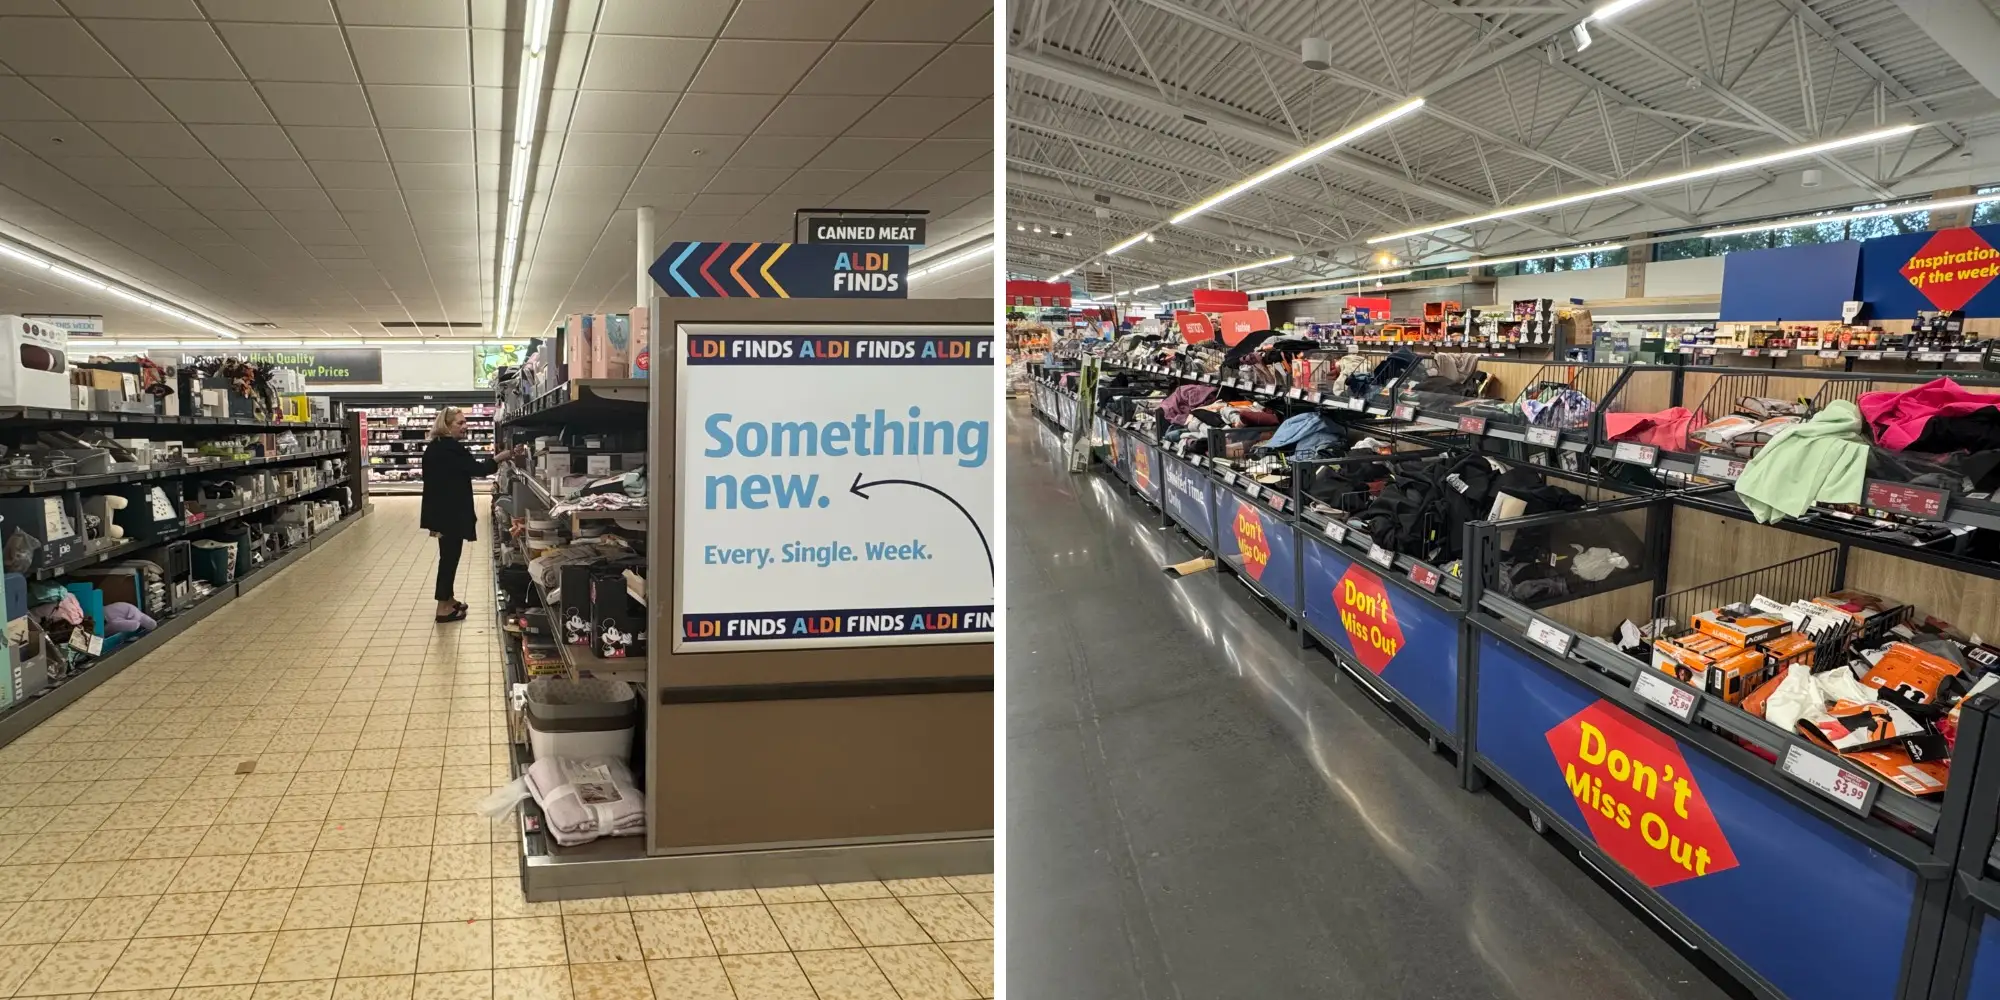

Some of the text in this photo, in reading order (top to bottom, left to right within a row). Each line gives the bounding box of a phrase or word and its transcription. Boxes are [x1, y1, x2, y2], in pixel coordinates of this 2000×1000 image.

[817, 226, 917, 240] CANNED MEAT
[834, 252, 889, 271] ALDI
[1908, 246, 2000, 269] Inspiration
[833, 273, 899, 292] FINDS
[1909, 263, 2000, 288] of the week
[276, 353, 315, 367] Quality
[687, 340, 725, 358] LDI
[732, 340, 793, 358] FINDS
[799, 340, 849, 359] ALDI
[856, 340, 915, 358] FINDS
[921, 341, 970, 358] ALDI
[318, 366, 350, 377] Prices
[704, 406, 989, 468] Something
[705, 473, 830, 510] new.
[1188, 478, 1204, 502] Time
[1238, 513, 1262, 543] Don't
[704, 539, 933, 569] Every. Single. Week.
[1238, 538, 1268, 565] Miss Out
[1344, 578, 1388, 624] Don't
[683, 620, 721, 637] LDI
[727, 618, 786, 636] FINDS
[792, 616, 841, 635] ALDI
[847, 614, 904, 632] FINDS
[910, 613, 958, 630] ALDI
[1341, 608, 1397, 657] Miss Out
[1668, 696, 1690, 710] $5.99
[1579, 720, 1692, 819] Don't
[1833, 779, 1864, 800] $3.99
[1565, 763, 1711, 877] Miss Out
